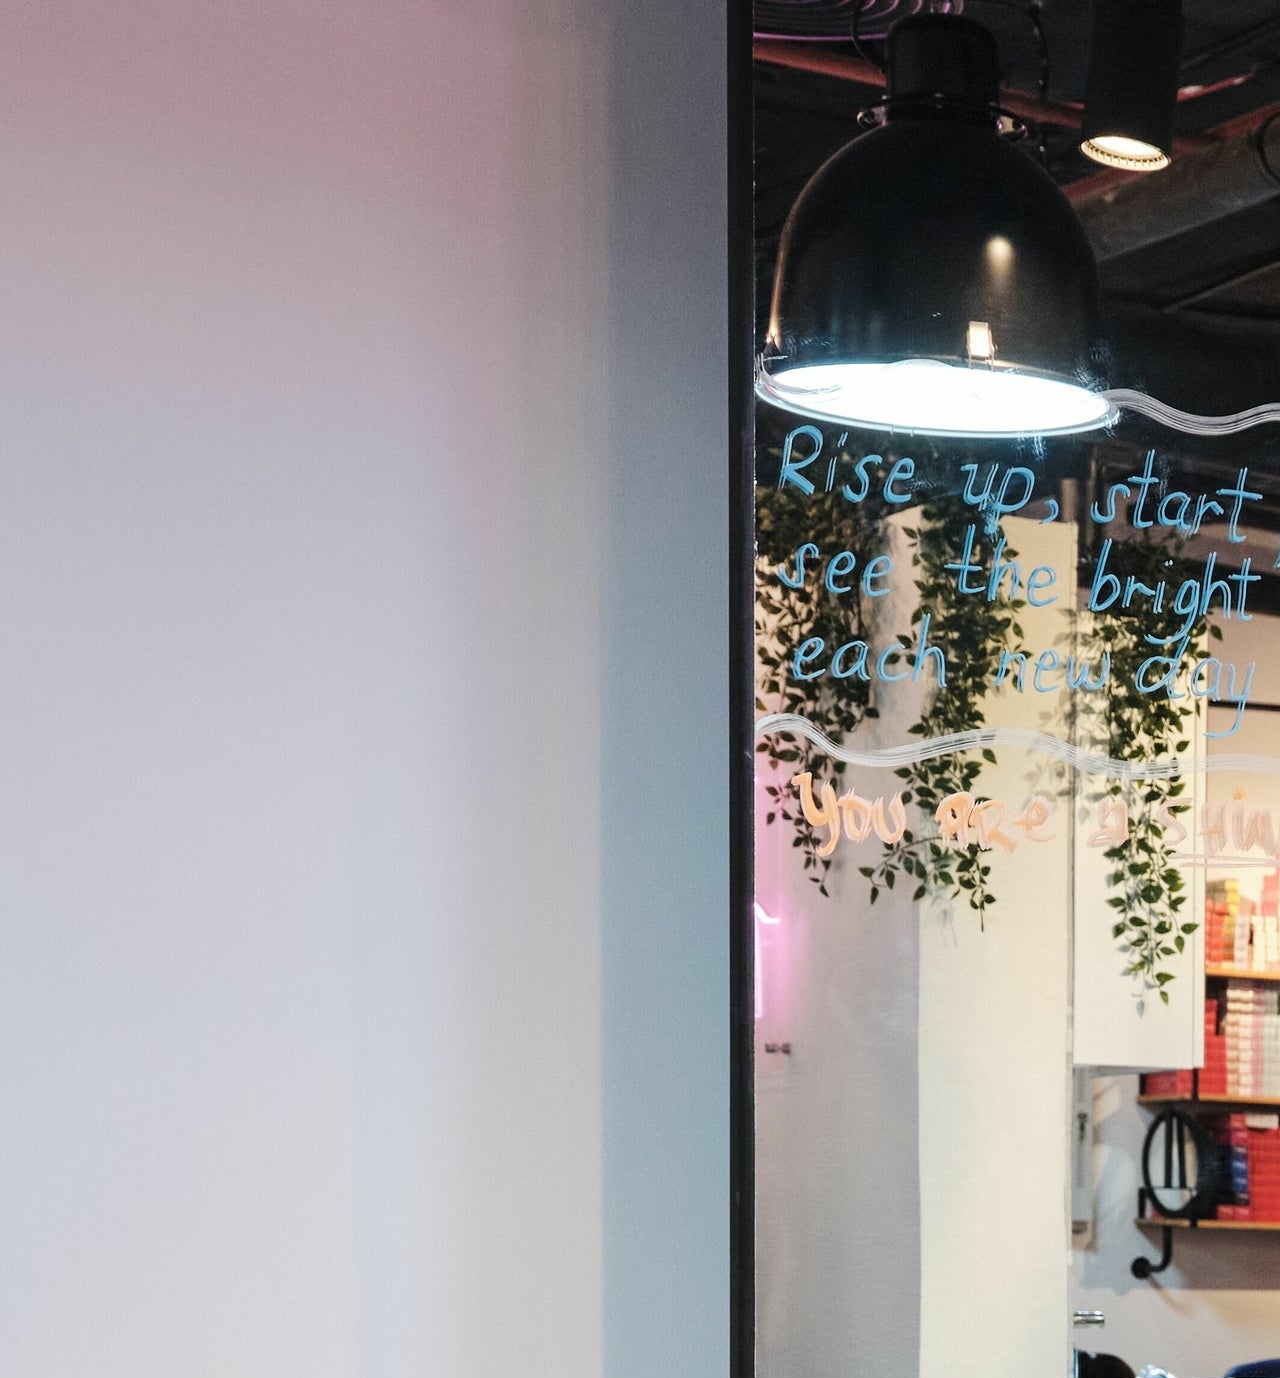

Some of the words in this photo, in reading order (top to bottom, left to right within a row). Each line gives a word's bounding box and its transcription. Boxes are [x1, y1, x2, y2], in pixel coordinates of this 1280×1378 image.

[780, 426, 915, 504] Rise
[1090, 449, 1264, 543] start
[779, 544, 895, 597] see
[944, 524, 1060, 606] the
[1088, 539, 1262, 646] bright
[793, 614, 947, 690] each
[995, 648, 1109, 694] new
[1135, 635, 1257, 737] day
